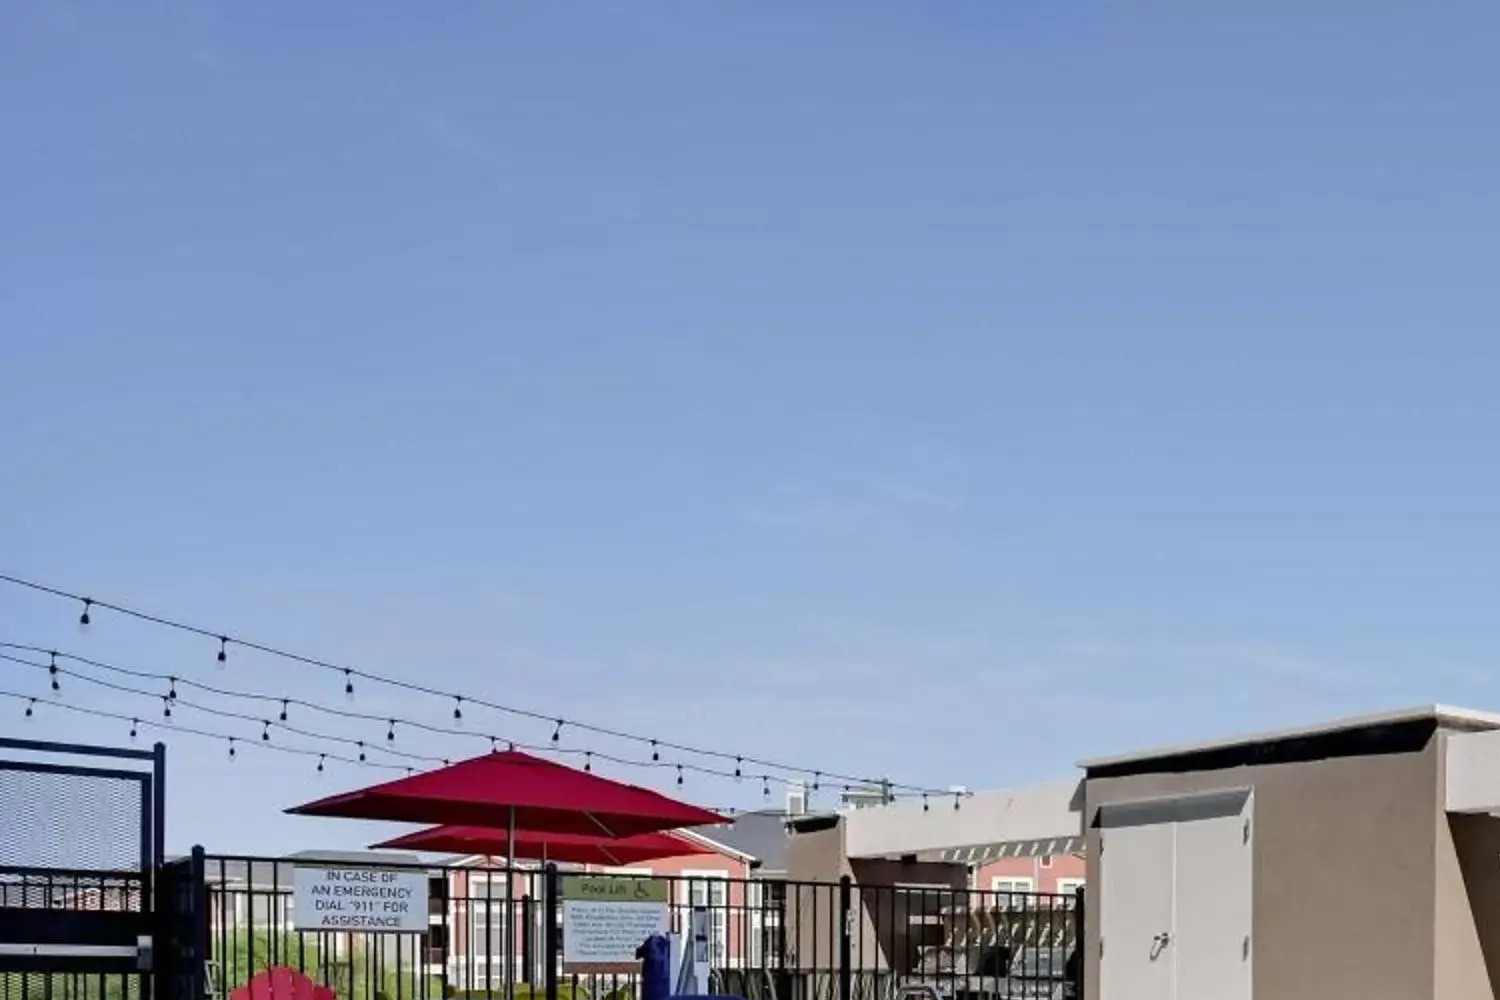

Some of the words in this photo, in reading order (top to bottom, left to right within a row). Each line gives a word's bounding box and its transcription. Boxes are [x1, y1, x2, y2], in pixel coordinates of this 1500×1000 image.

[328, 871, 340, 880] IN
[344, 872, 377, 882] CASE
[312, 885, 331, 896] AN
[334, 886, 413, 899] EMERGENCY
[315, 900, 345, 910] DIAL
[383, 902, 409, 912] FOR
[321, 916, 400, 927] ASSISTANCE
